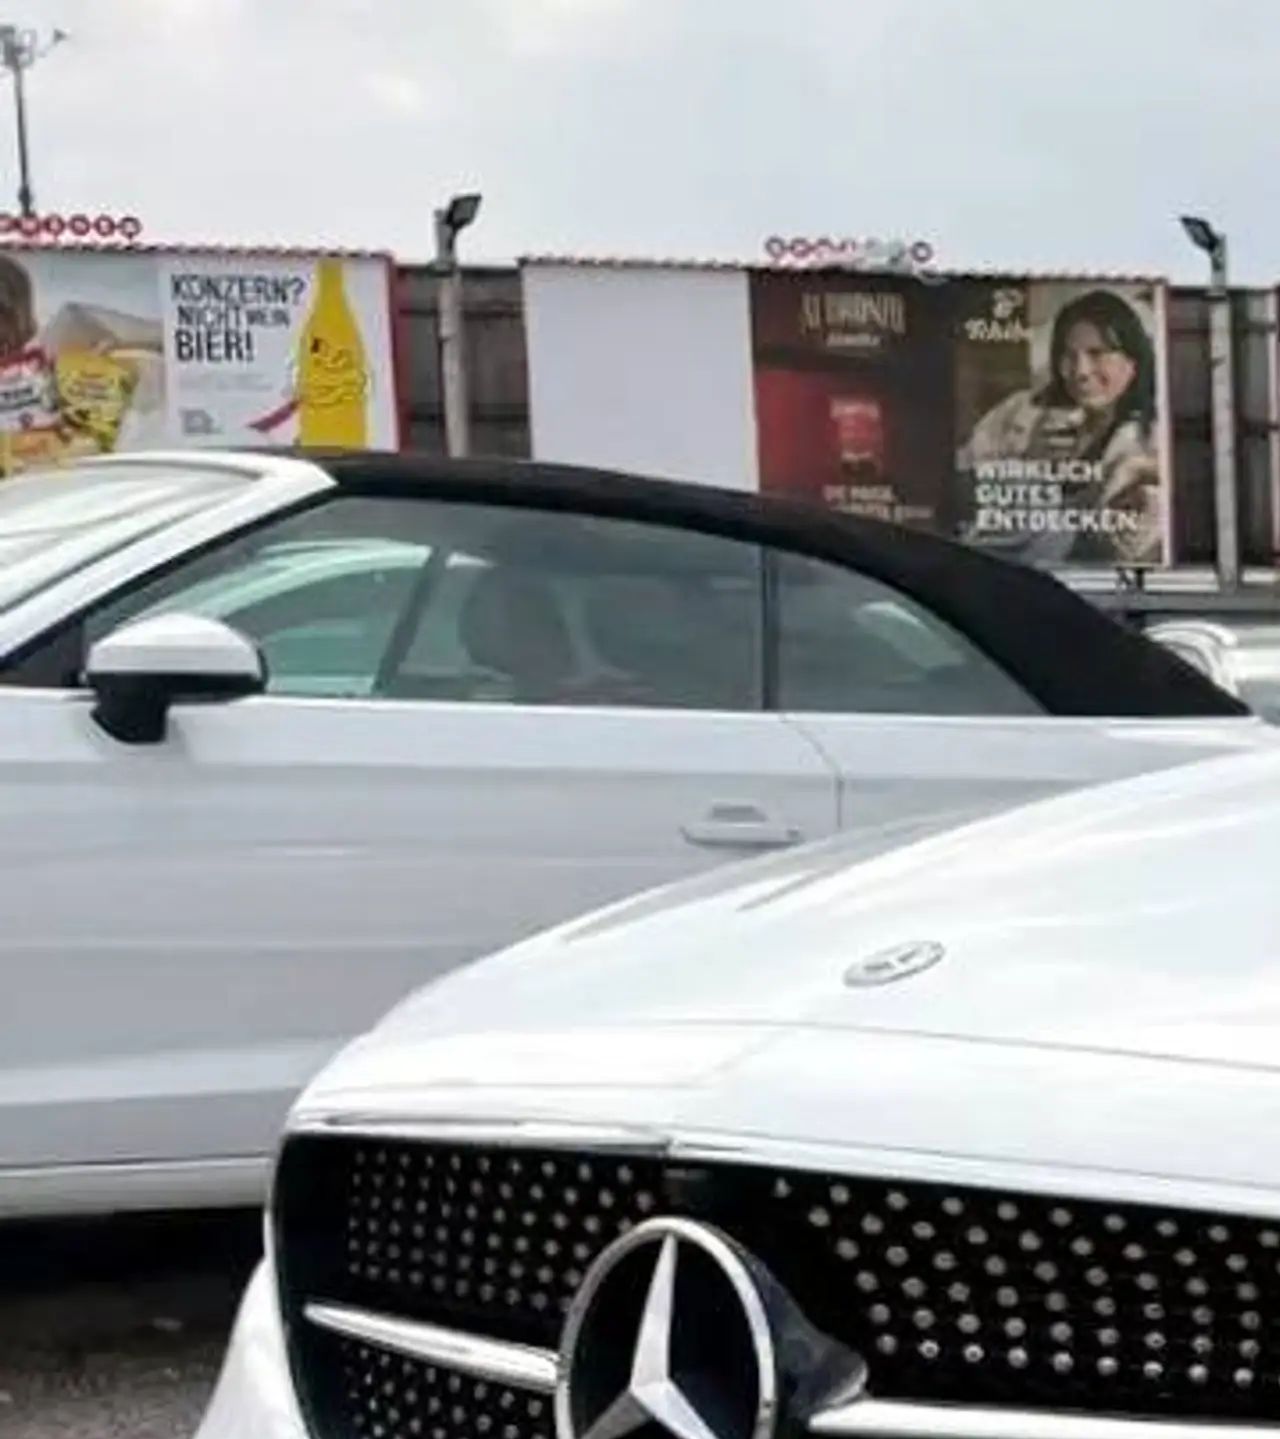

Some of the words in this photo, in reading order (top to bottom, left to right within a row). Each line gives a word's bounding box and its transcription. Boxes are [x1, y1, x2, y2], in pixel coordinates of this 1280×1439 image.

[171, 273, 307, 306] KONZERN?
[175, 329, 254, 362] BIER!
[976, 460, 1103, 482] WIRKLICH
[976, 484, 1063, 506] GUTES
[976, 508, 1139, 533] ENTDECKEN
